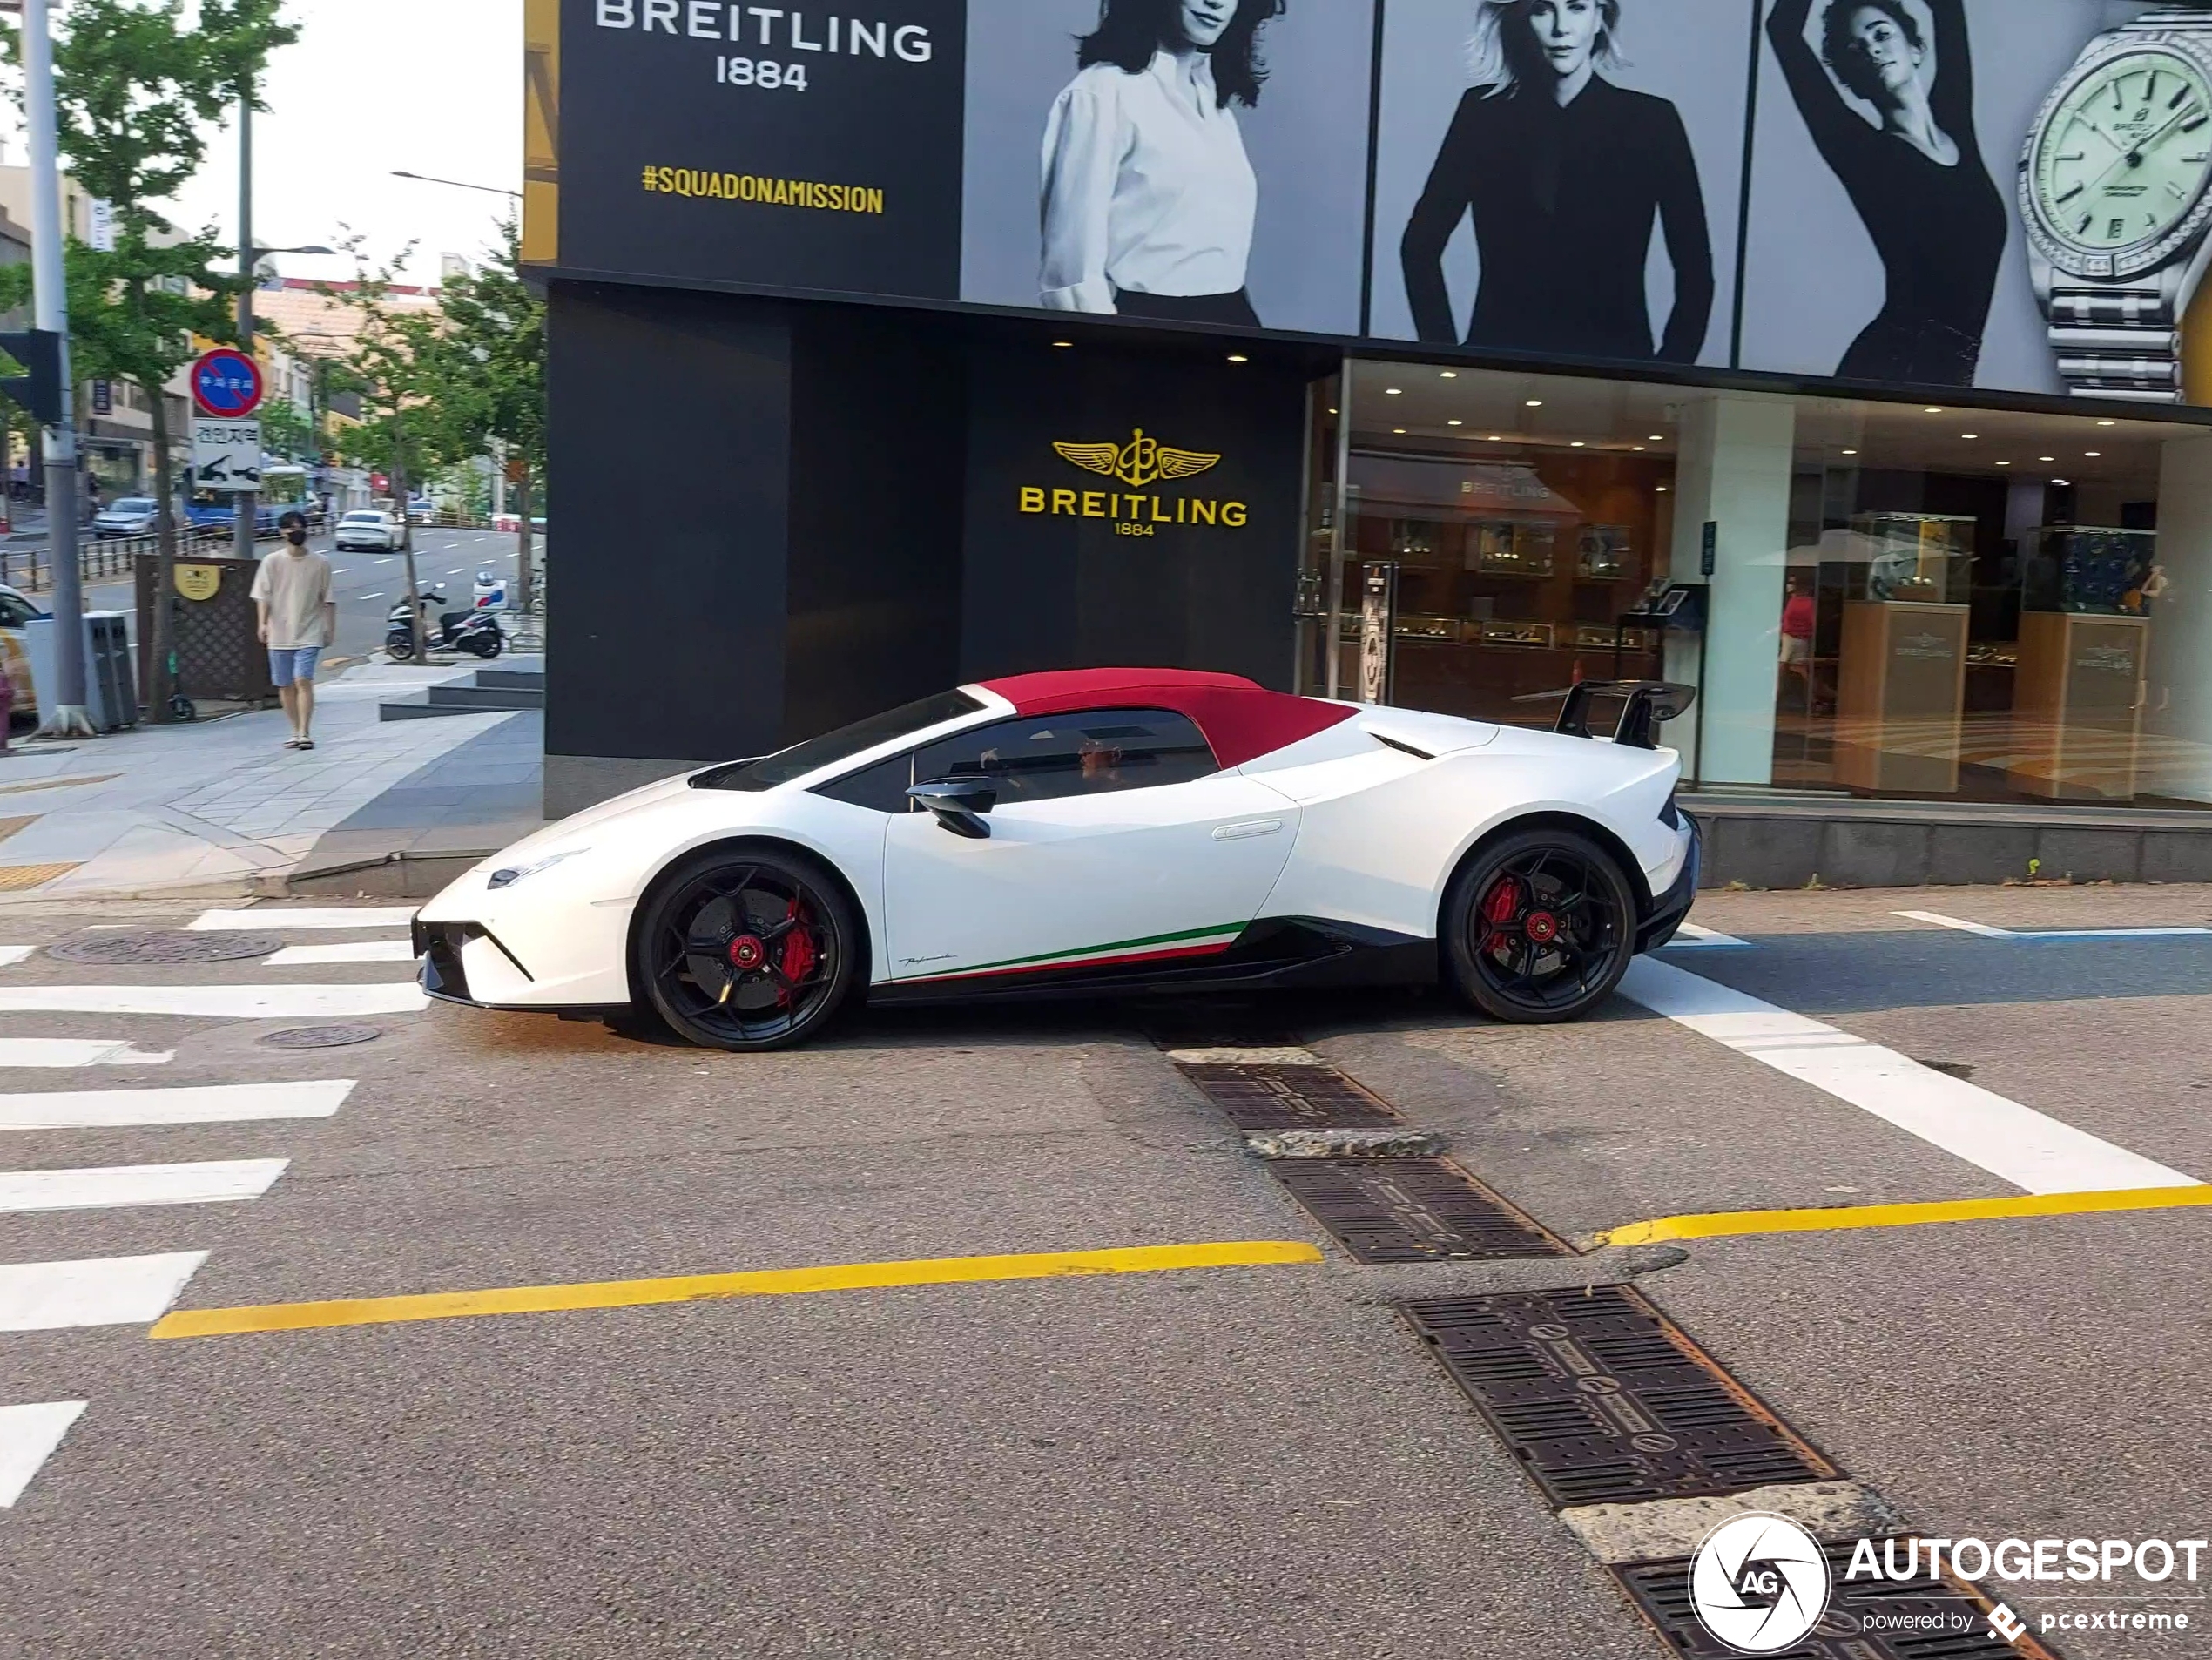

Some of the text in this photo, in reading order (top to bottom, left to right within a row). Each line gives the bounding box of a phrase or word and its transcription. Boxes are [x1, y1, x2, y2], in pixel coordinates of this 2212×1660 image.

[596, 0, 933, 63] BREITLING
[717, 55, 808, 91] 1884
[642, 165, 883, 214] #SQUADONAMISSION
[196, 425, 258, 445] 견인지역
[1020, 486, 1248, 528] BREITLING
[1115, 523, 1155, 536] 1884
